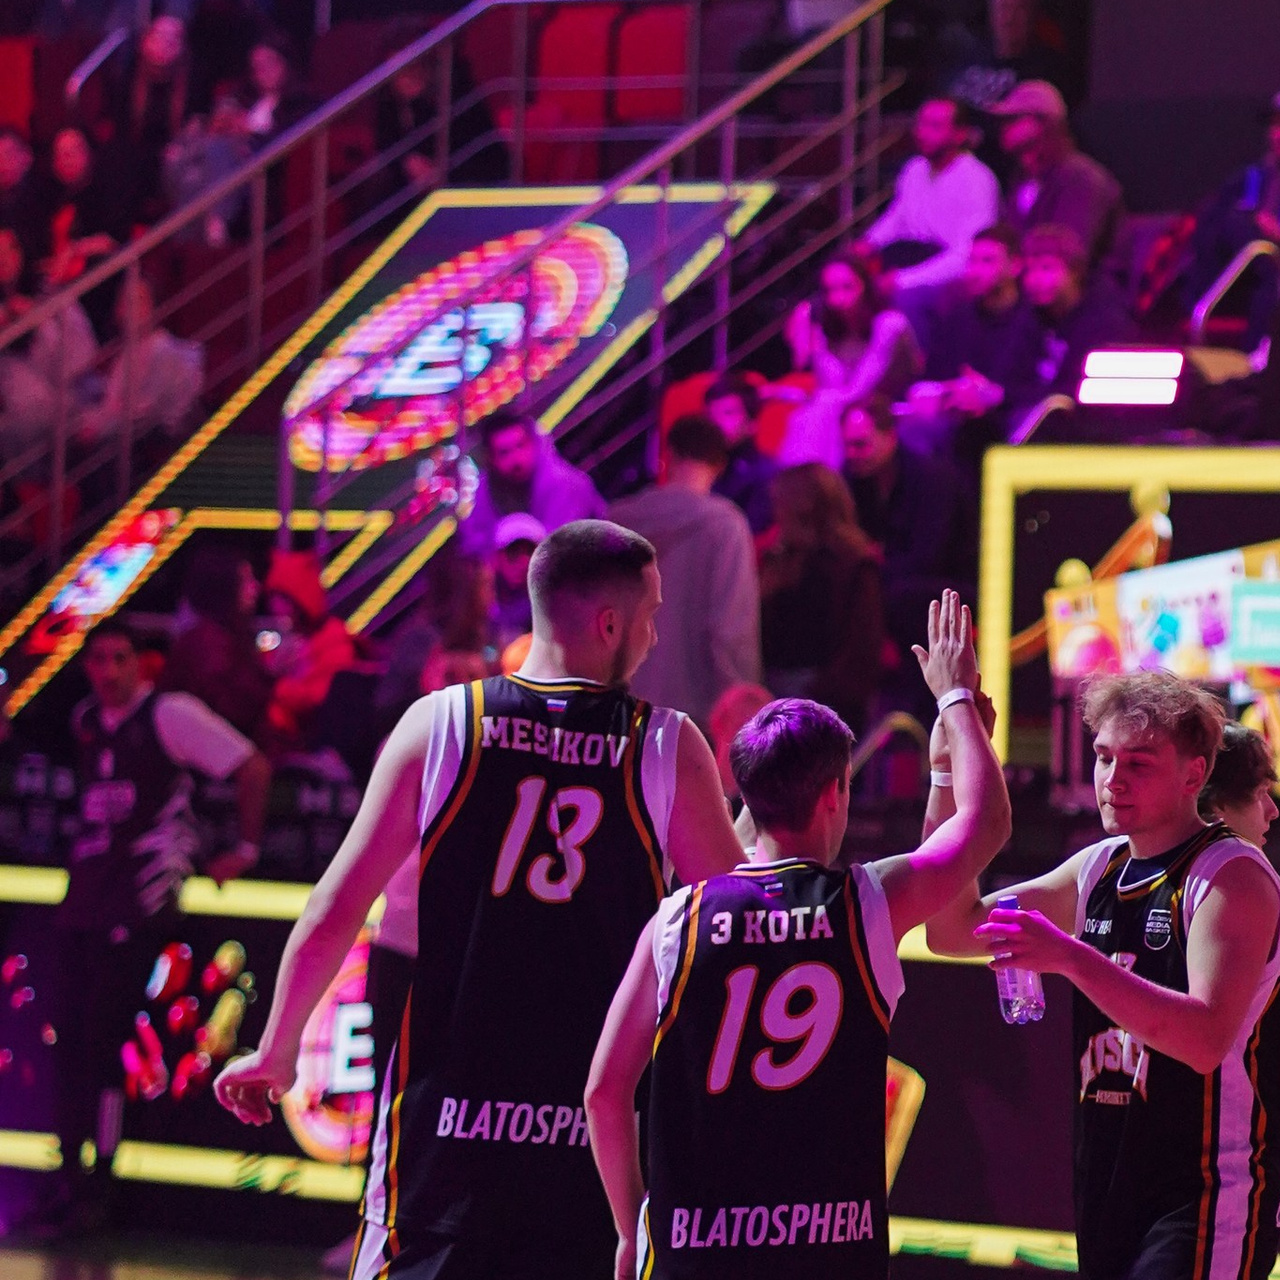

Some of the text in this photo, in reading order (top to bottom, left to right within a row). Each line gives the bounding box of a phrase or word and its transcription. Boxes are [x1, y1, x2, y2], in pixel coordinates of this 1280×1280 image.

[491, 774, 604, 903] 13
[710, 911, 733, 945] 3
[706, 960, 844, 1095] 19
[436, 1097, 590, 1148] BLATOSPH
[671, 1199, 873, 1249] BLATOSPHERA
